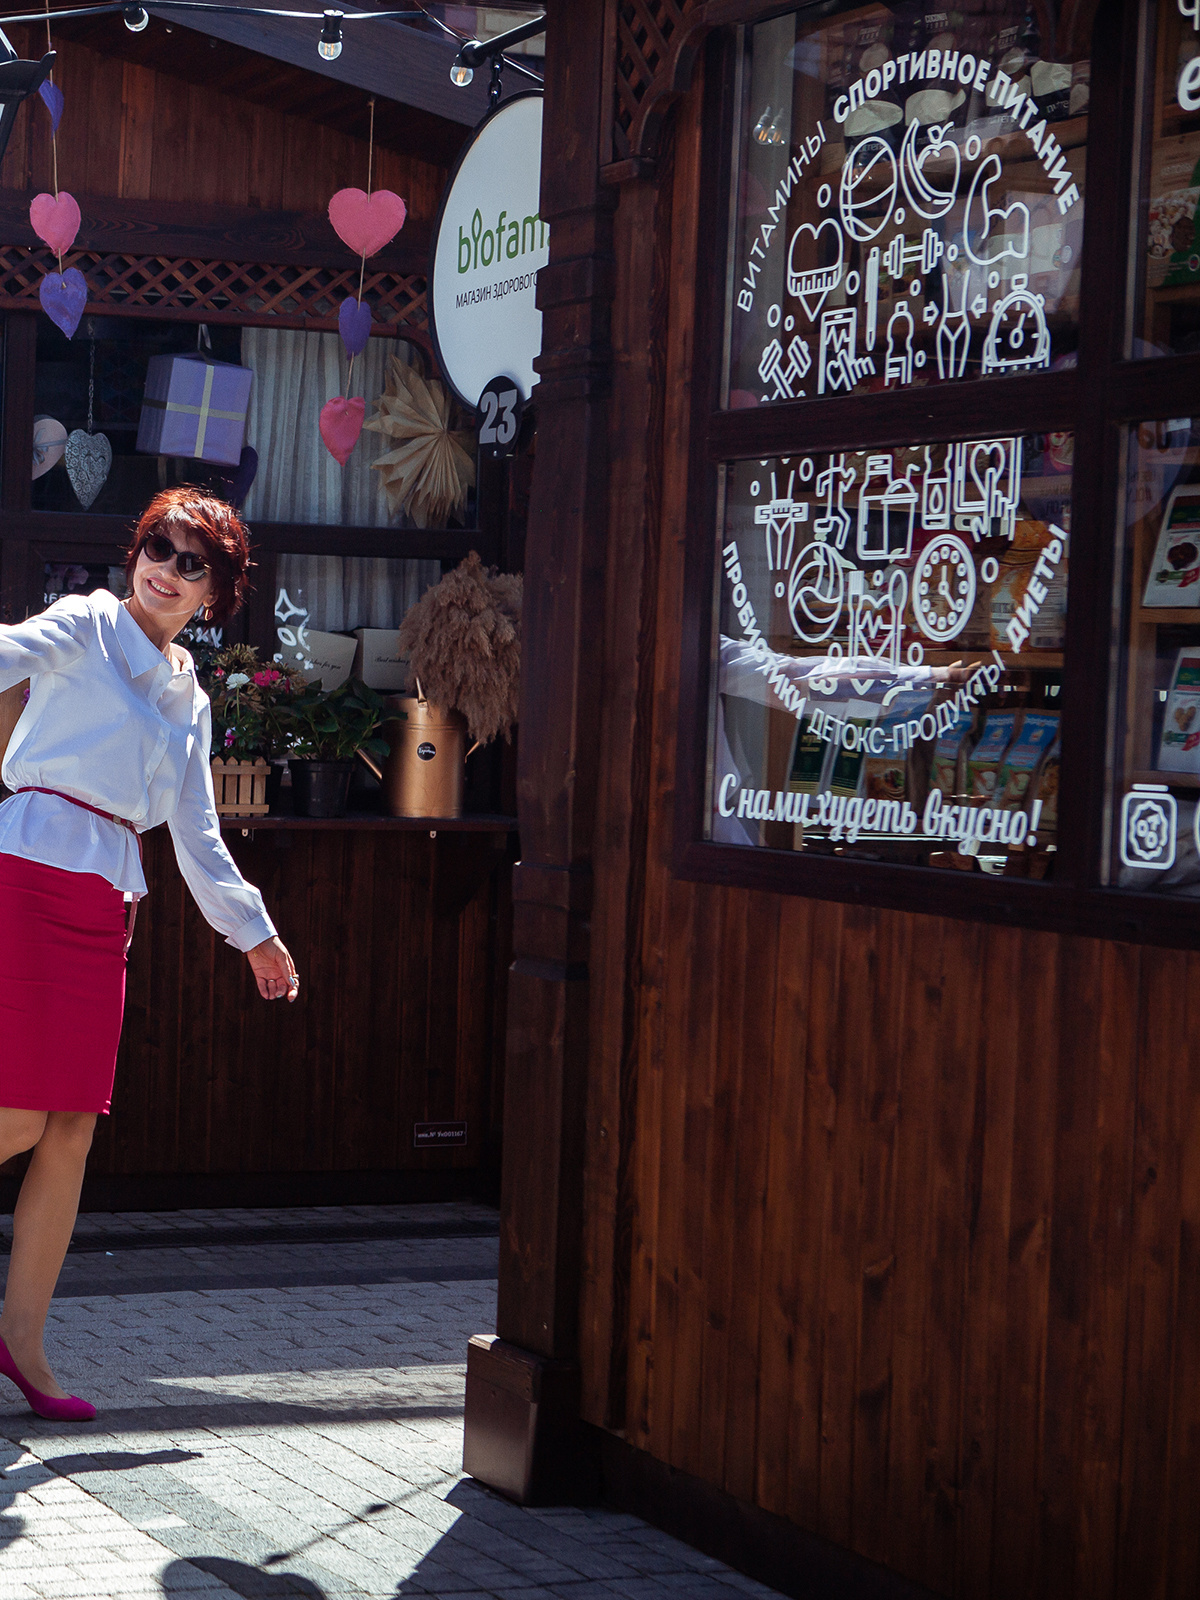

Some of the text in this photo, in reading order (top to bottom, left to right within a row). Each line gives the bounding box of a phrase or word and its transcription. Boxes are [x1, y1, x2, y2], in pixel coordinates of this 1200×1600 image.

[737, 49, 1080, 313] ВИТАМИНЫ СПОРТИВНОЕ ПИТАНИЕ
[457, 207, 550, 274] biofam
[456, 285, 492, 309] МАГАЗИН
[479, 388, 518, 444] 23
[723, 541, 806, 720] ПРОБИОТИКИ
[807, 650, 1007, 754] ДЕТОКС-ПРОДУКТЫ
[1005, 523, 1068, 653] ДИЕТЫ
[718, 773, 737, 818] С
[807, 785, 916, 844] худеть
[922, 787, 1042, 856] вкусно!
